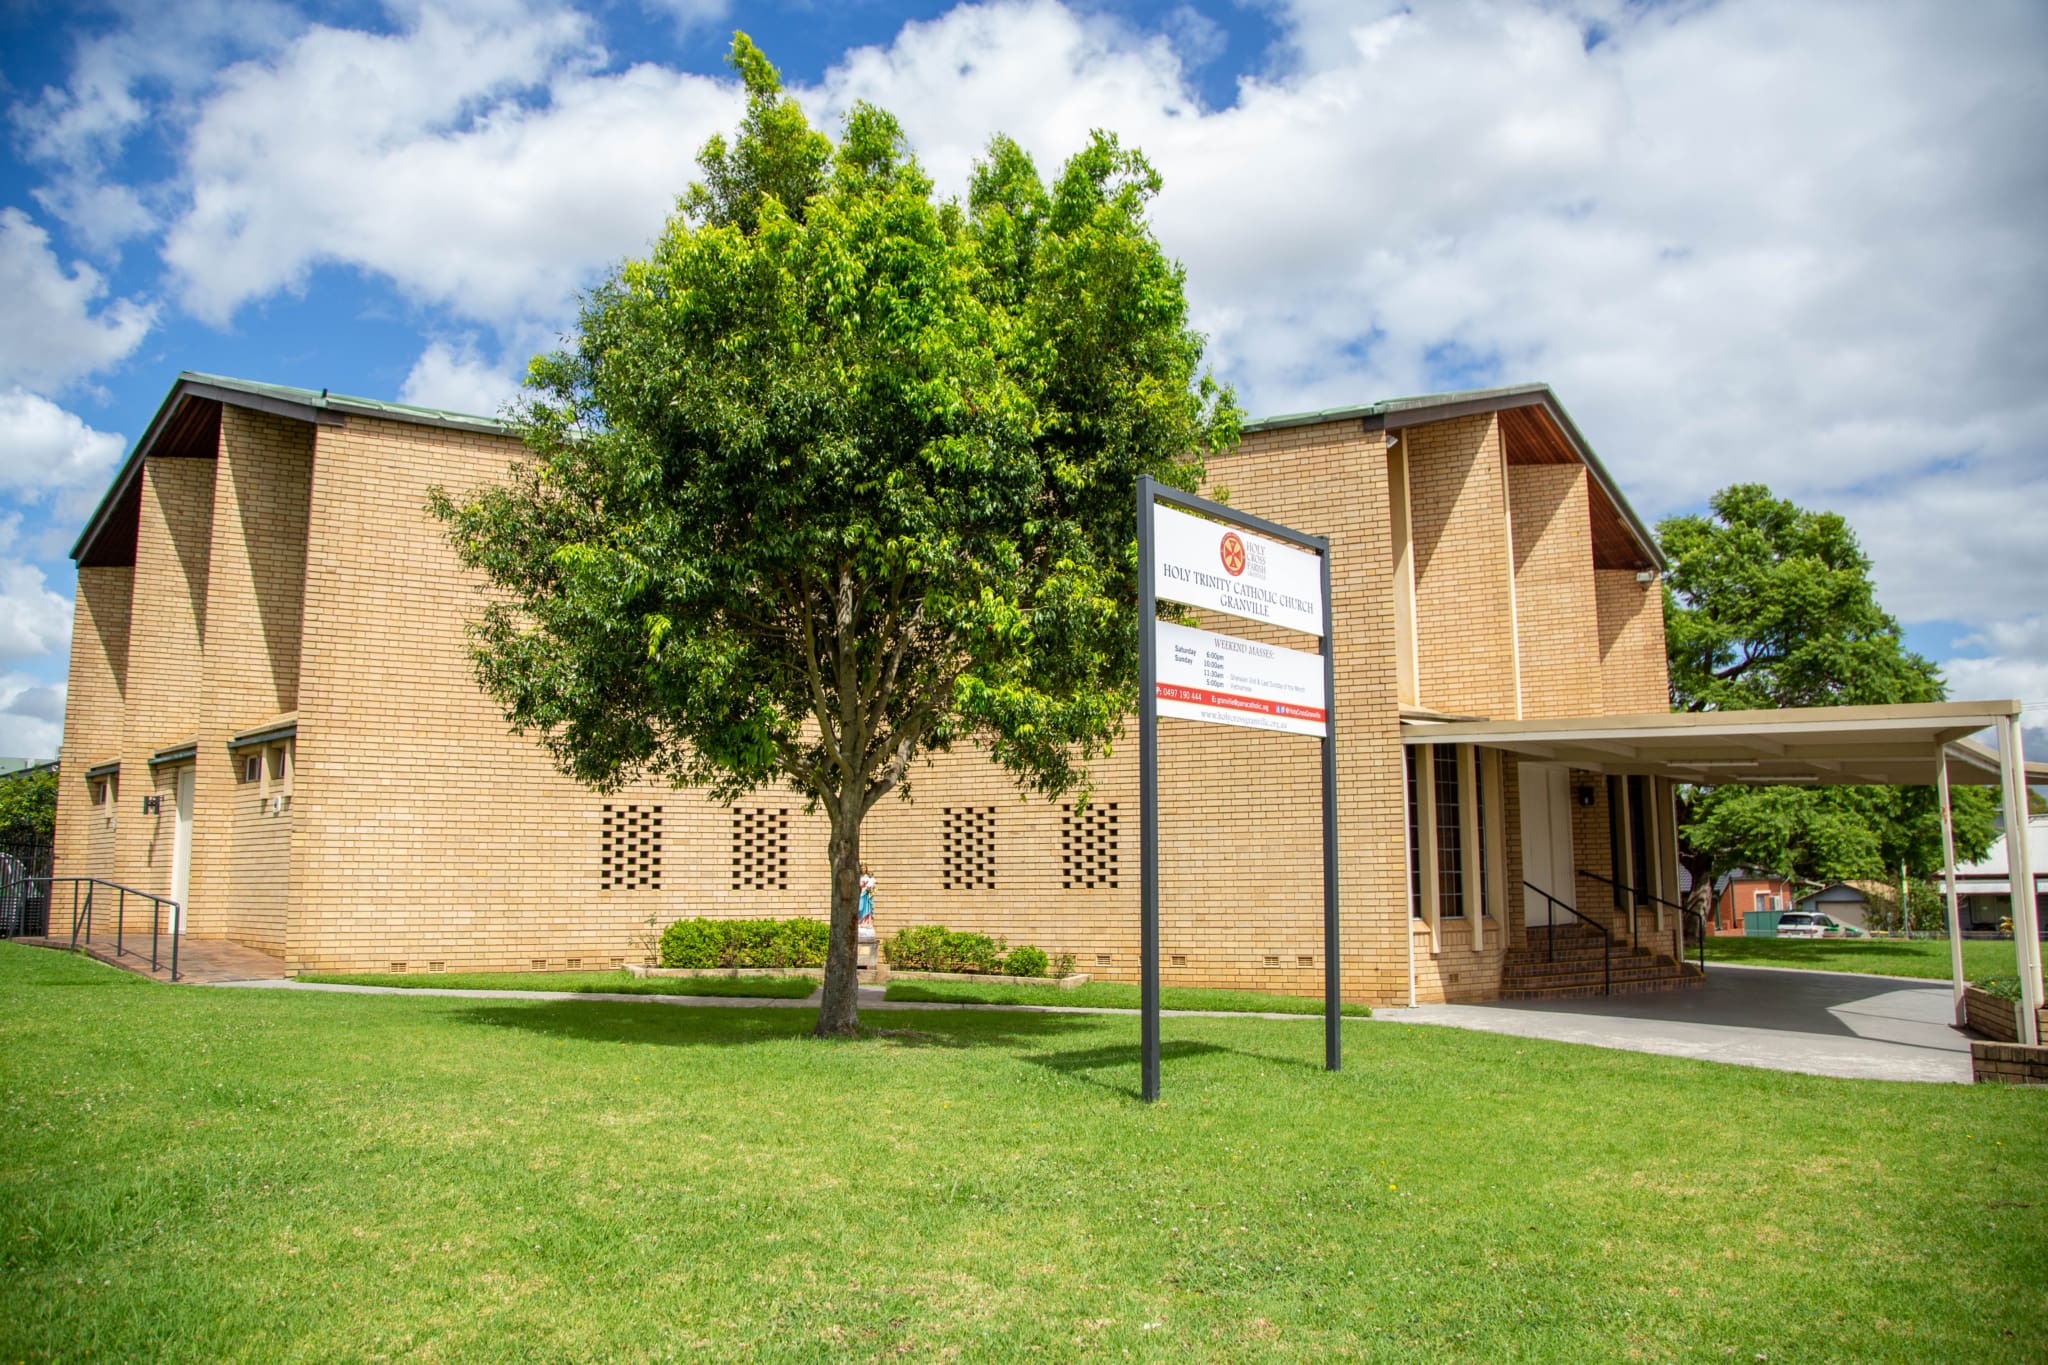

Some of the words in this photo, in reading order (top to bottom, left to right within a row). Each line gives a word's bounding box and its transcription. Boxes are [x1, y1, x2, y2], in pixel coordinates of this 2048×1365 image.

[1163, 563, 1191, 582] HOLY
[1193, 571, 1232, 592] TRINITY
[1233, 582, 1278, 605] CATHOLIC
[1279, 594, 1314, 614] CHURCH
[1220, 595, 1269, 617] GRANVILLE
[1174, 644, 1196, 657] Saturday
[1214, 638, 1247, 653] WEEKEND
[1174, 654, 1193, 665] Sunday
[1163, 687, 1178, 697] 0497
